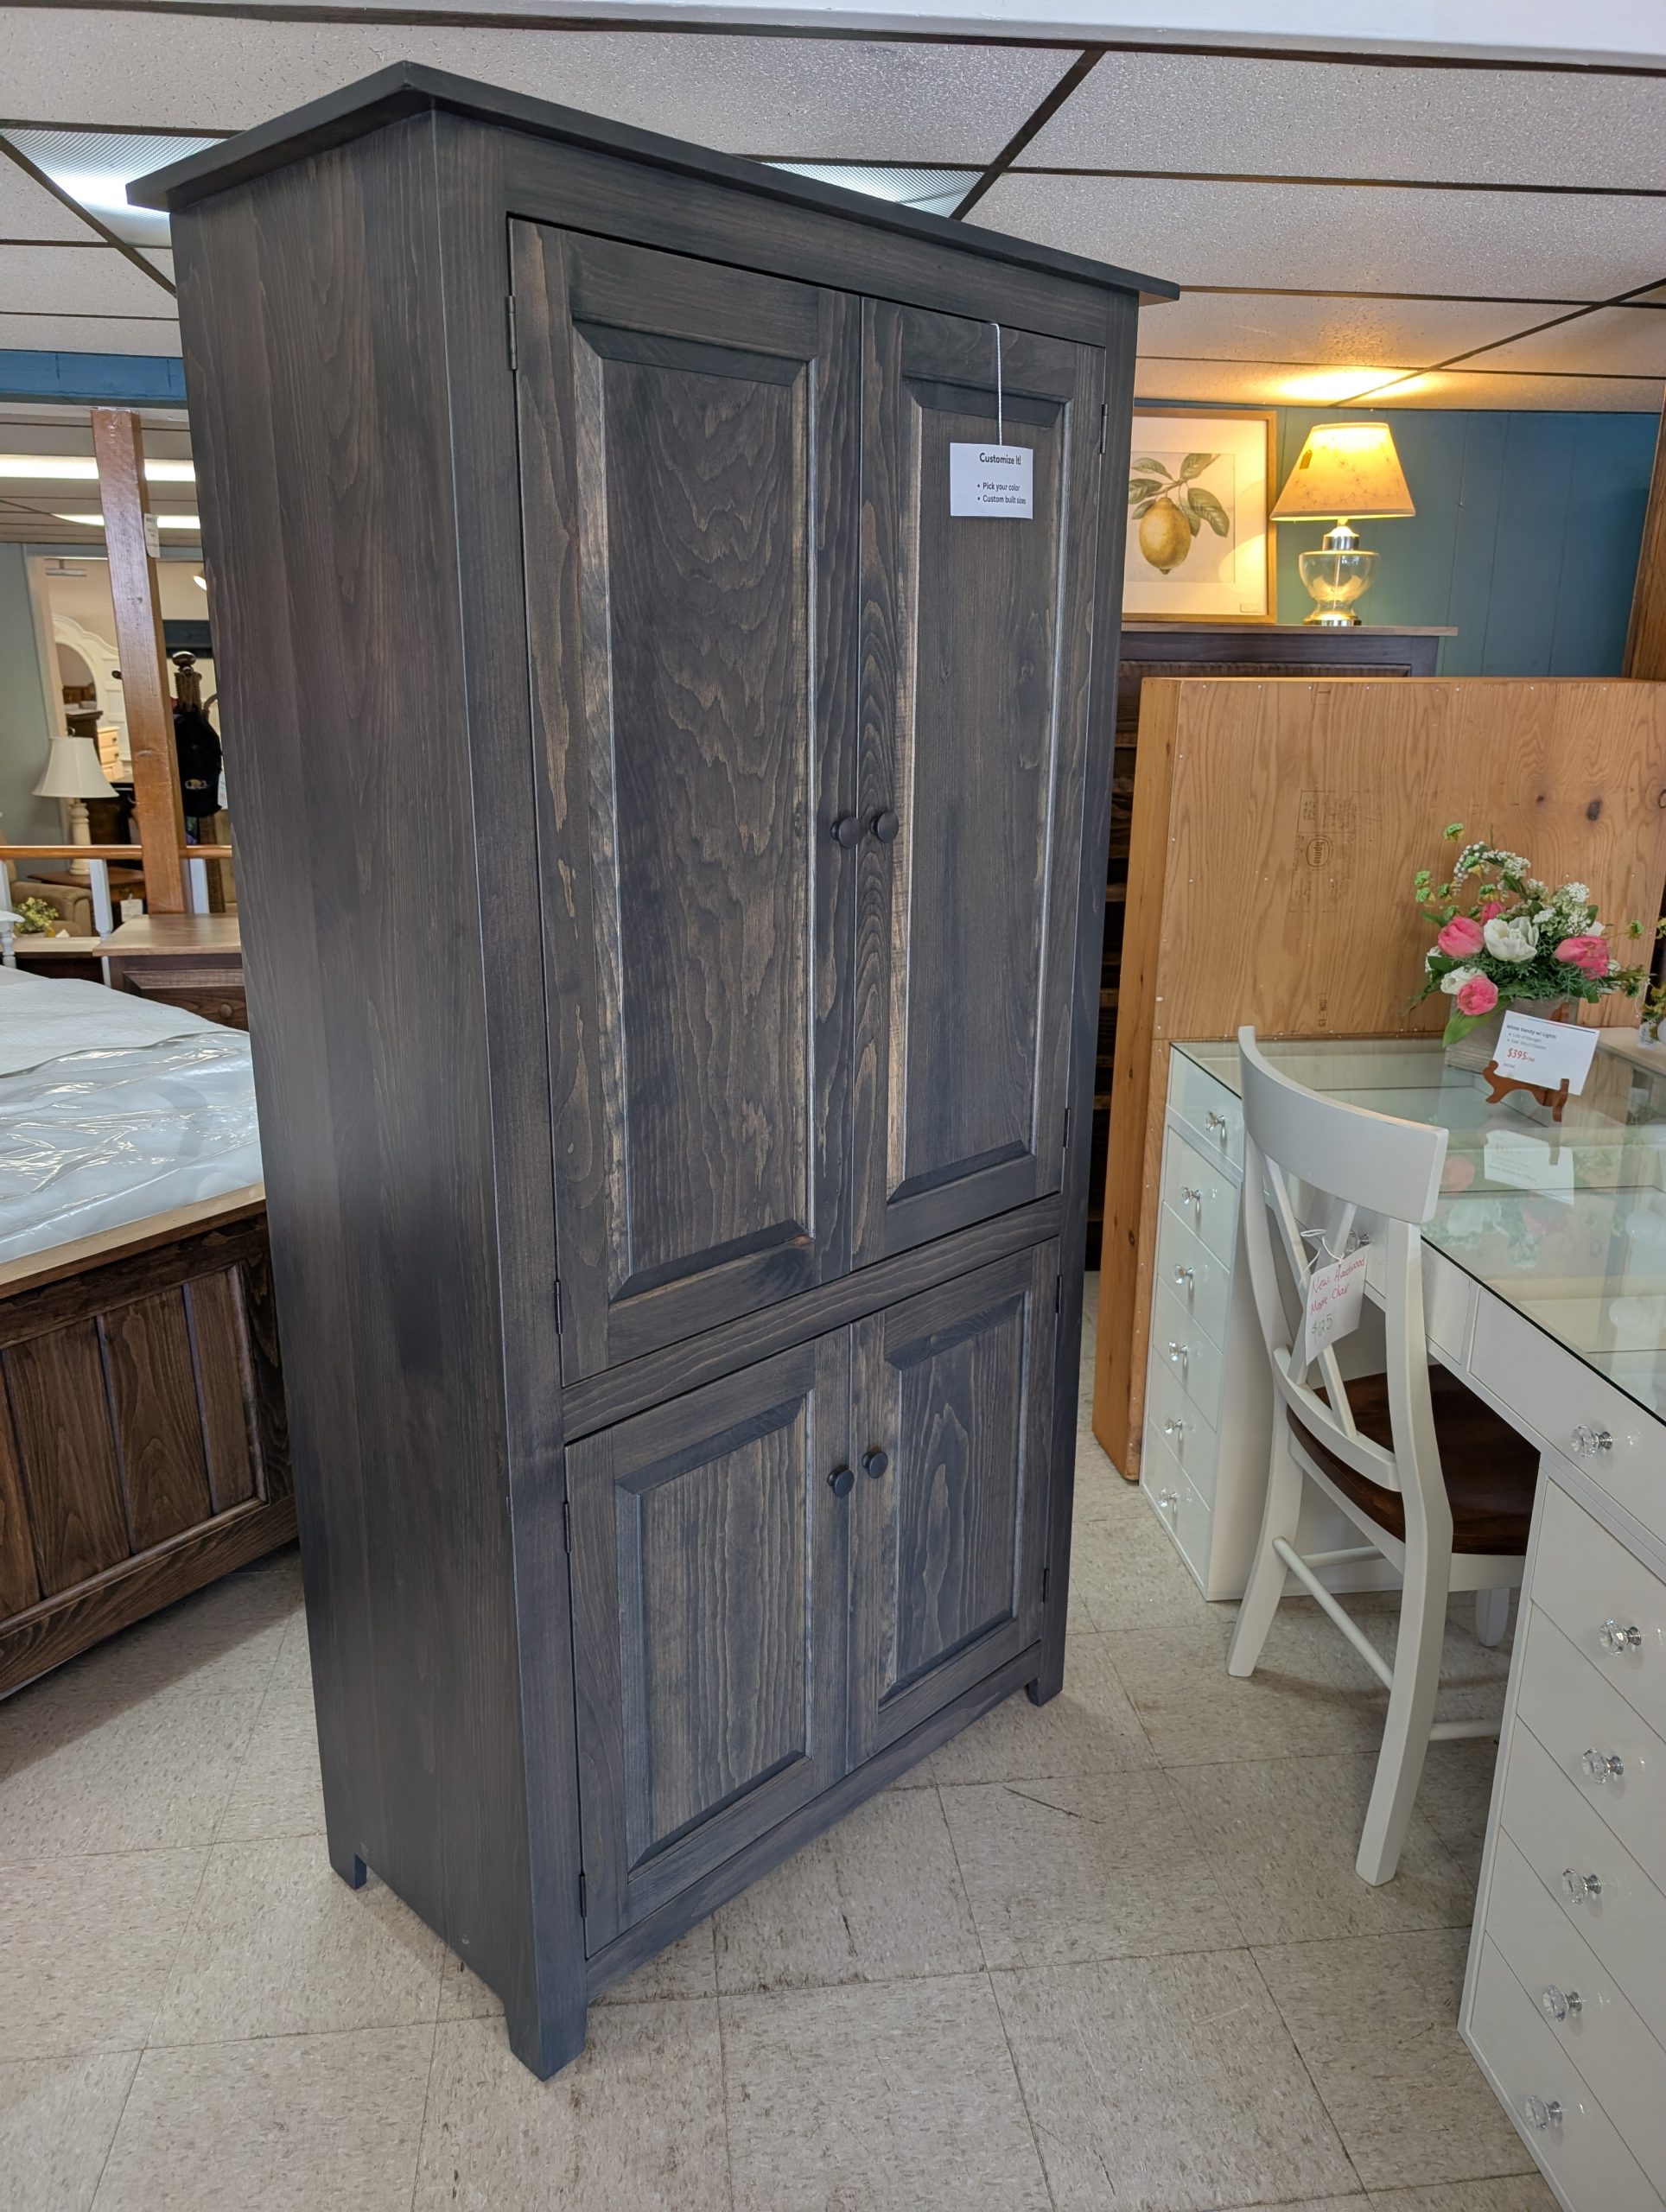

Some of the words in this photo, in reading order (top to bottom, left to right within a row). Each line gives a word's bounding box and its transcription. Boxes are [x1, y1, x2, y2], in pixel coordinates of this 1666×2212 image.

[979, 452, 1014, 465] Customize
[982, 482, 995, 491] Pick
[995, 483, 1008, 492] your
[982, 494, 1004, 503] Custom
[1005, 495, 1016, 504] built
